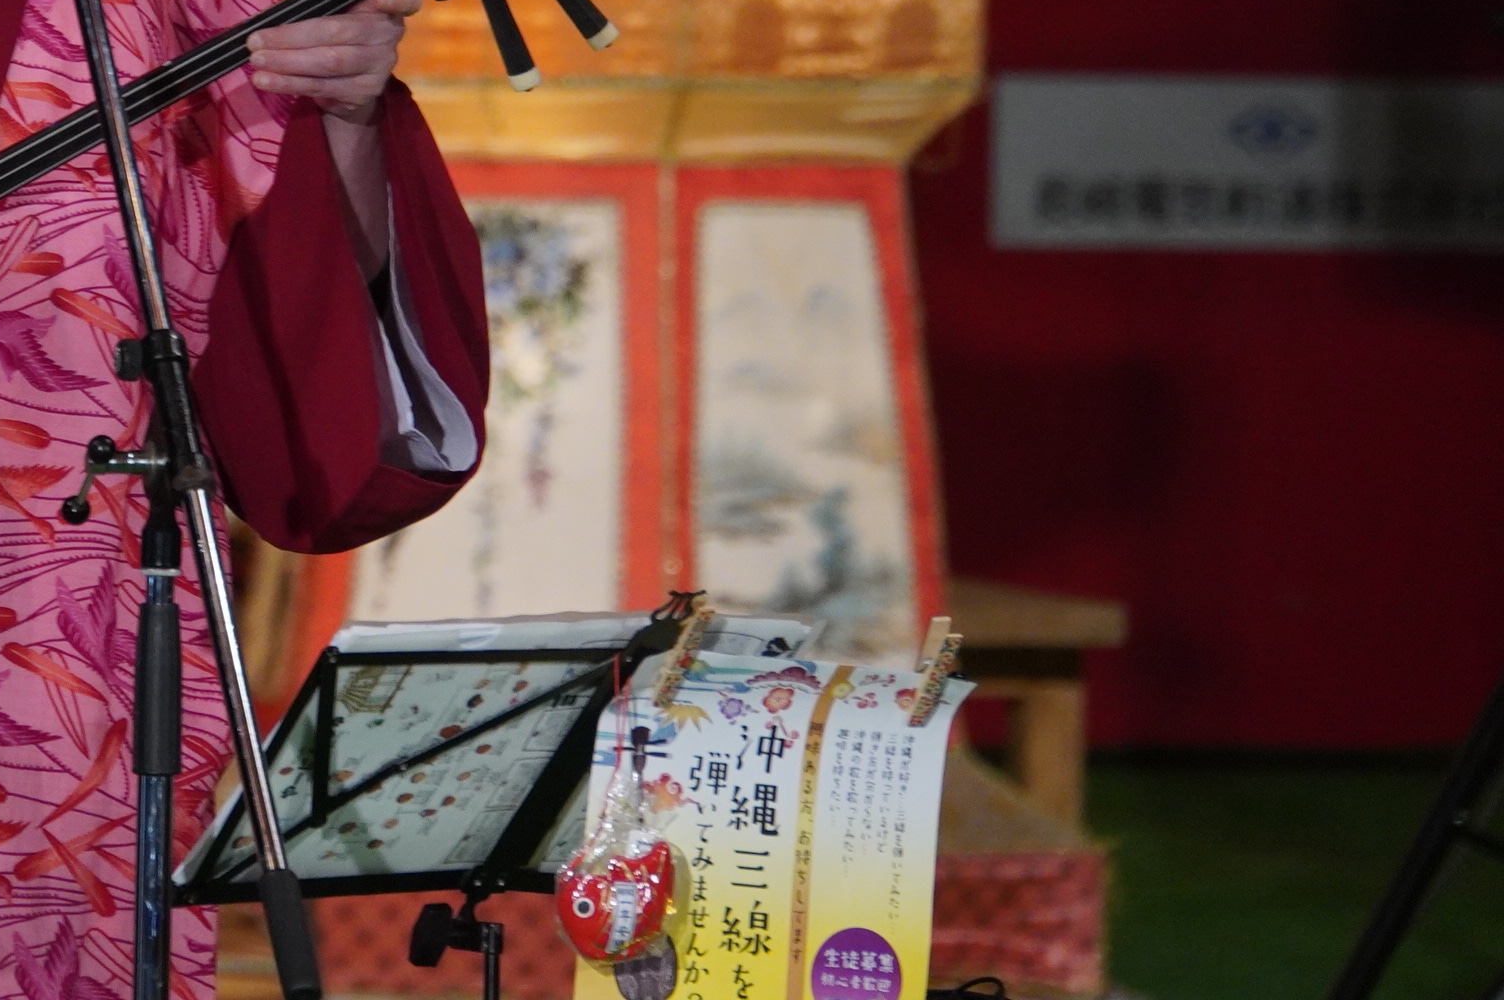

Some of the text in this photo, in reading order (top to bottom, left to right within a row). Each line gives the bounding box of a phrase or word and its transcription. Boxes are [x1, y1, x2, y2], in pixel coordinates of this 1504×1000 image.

[718, 724, 785, 999] 沖縄三線を
